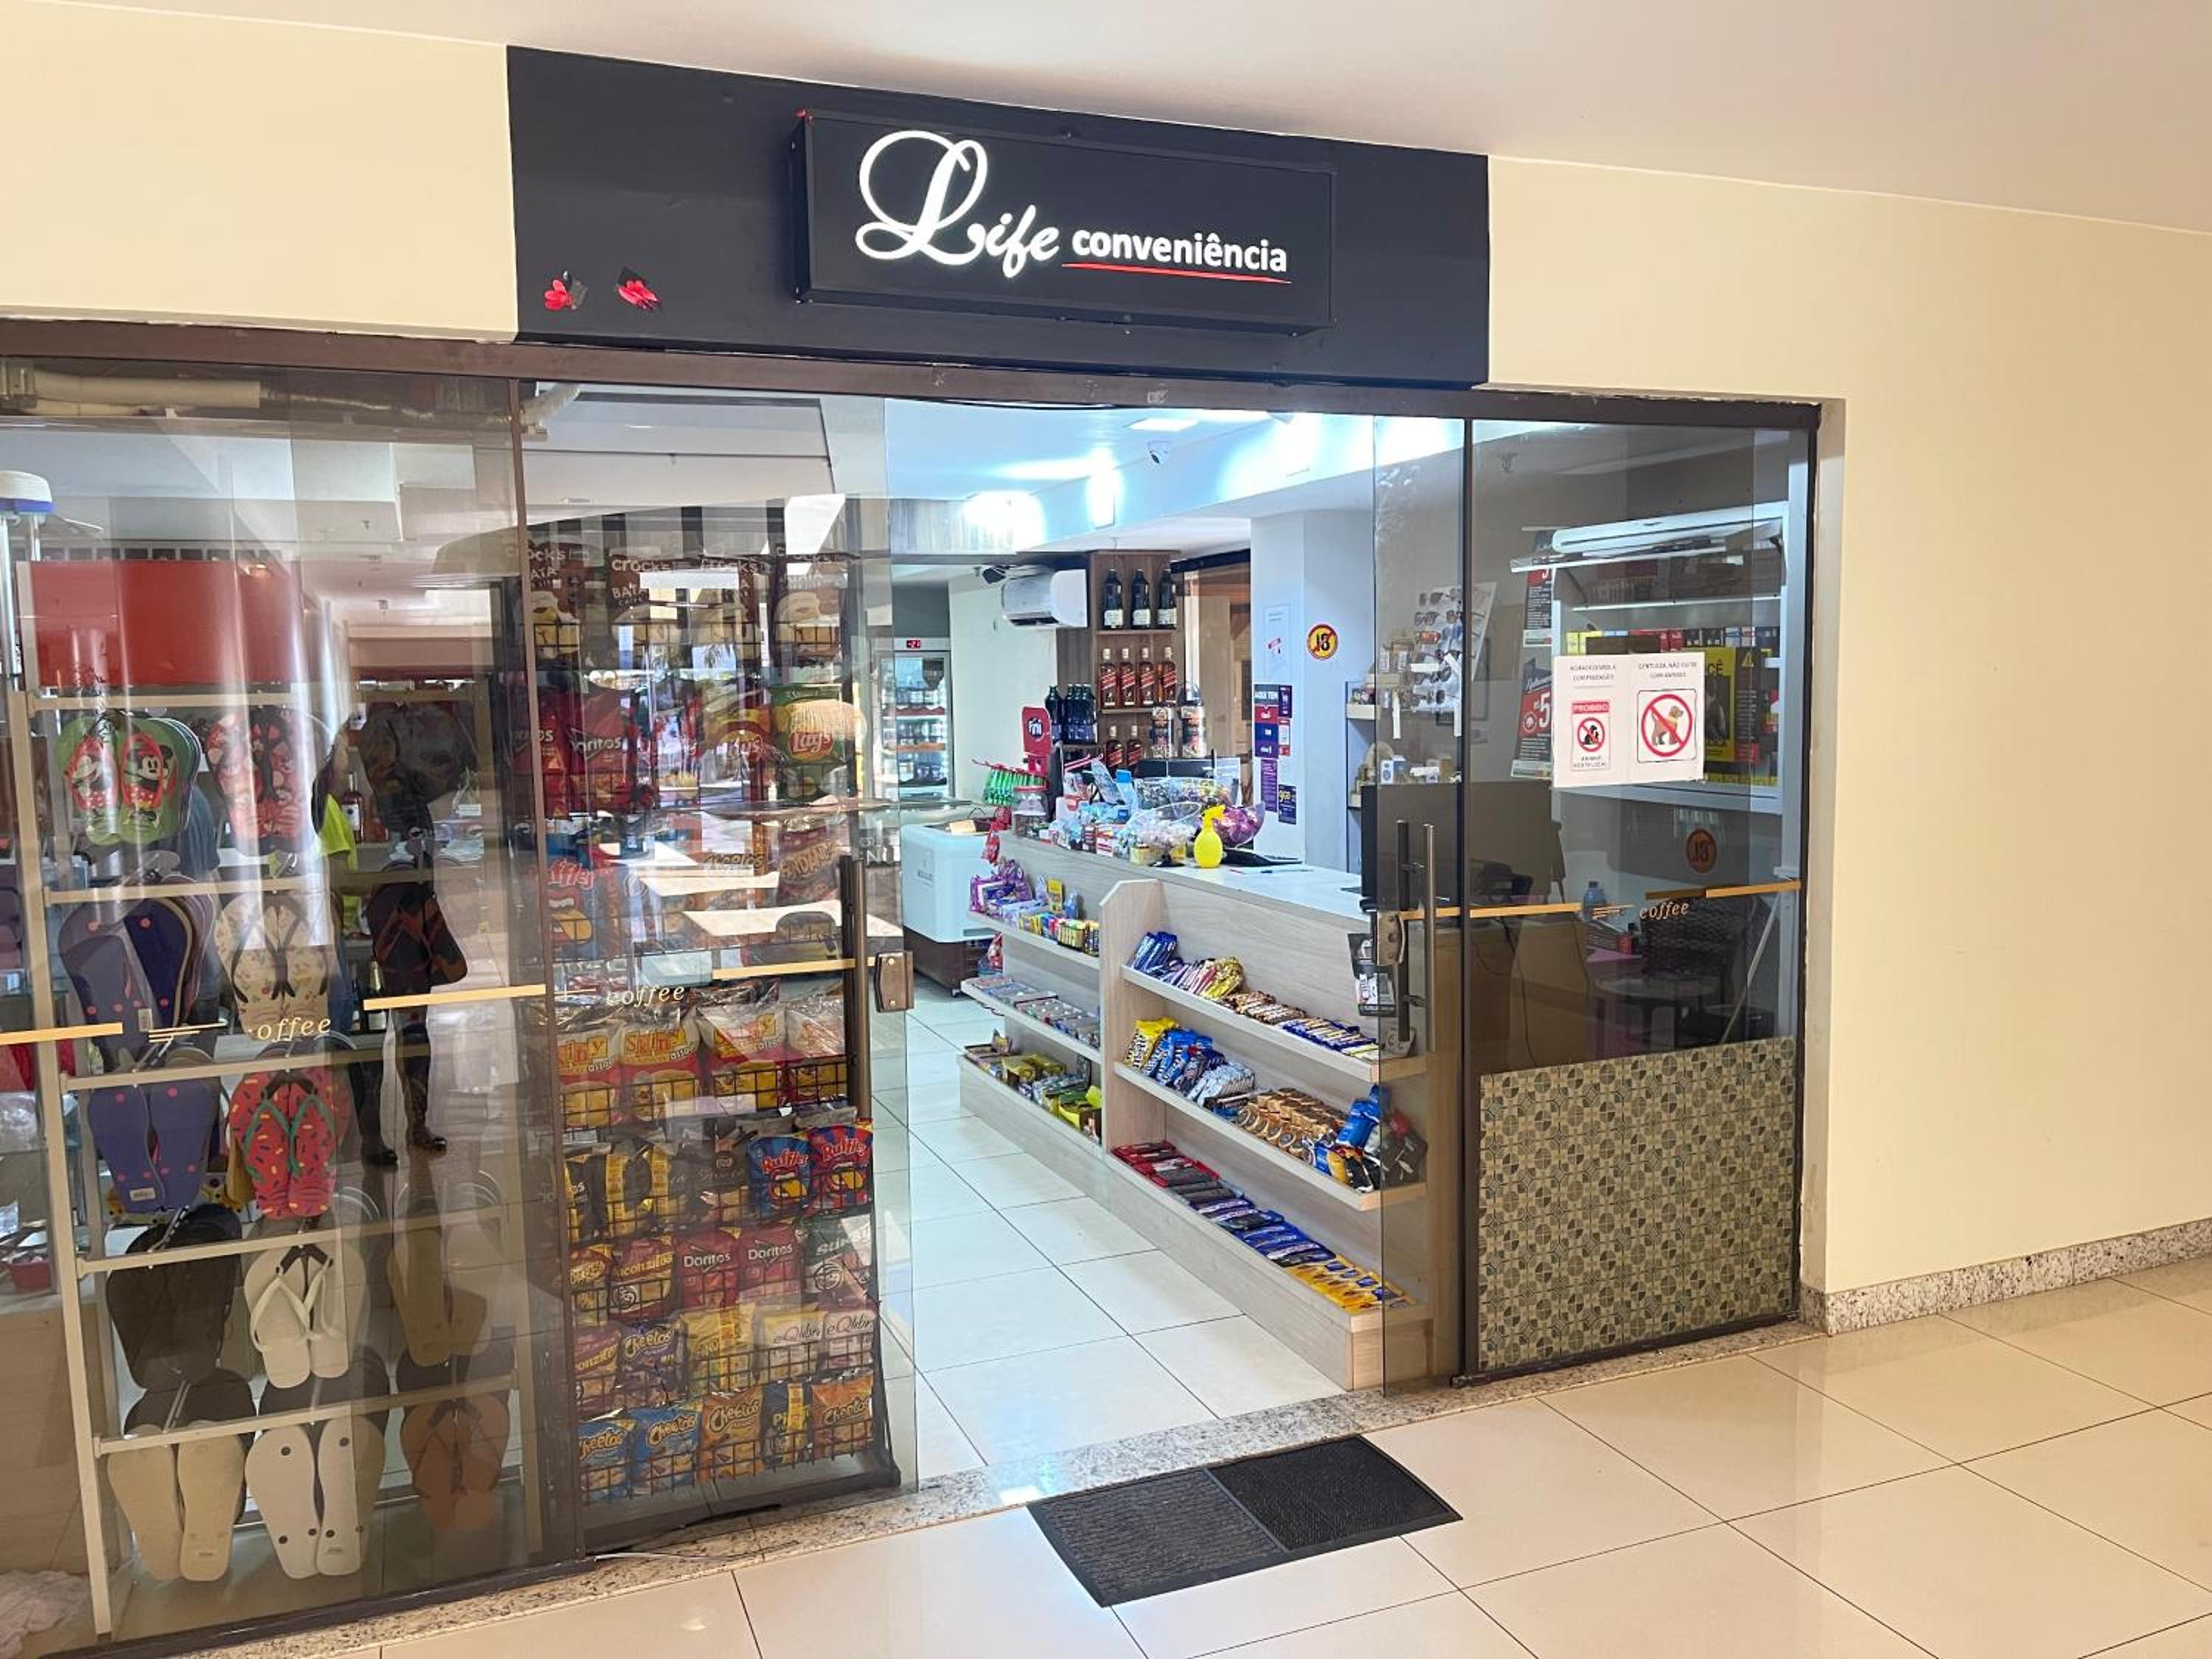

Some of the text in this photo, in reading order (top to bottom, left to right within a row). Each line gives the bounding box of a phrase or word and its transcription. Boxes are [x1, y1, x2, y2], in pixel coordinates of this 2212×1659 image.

[855, 130, 1287, 278] Life conveniência
[1316, 633, 1330, 651] 18
[1707, 660, 1723, 675] CÊ
[1638, 900, 1689, 921] coffee
[605, 984, 686, 1009] coffee
[248, 1017, 331, 1043] offee
[761, 1148, 810, 1174] Ruffles
[821, 1138, 867, 1163] Ruffles
[684, 1253, 731, 1267] Doritos
[748, 1243, 793, 1261] Doritos
[625, 1329, 673, 1358] Cheetos
[709, 1399, 761, 1432] Cheetos
[647, 1414, 696, 1445] Cheetos
